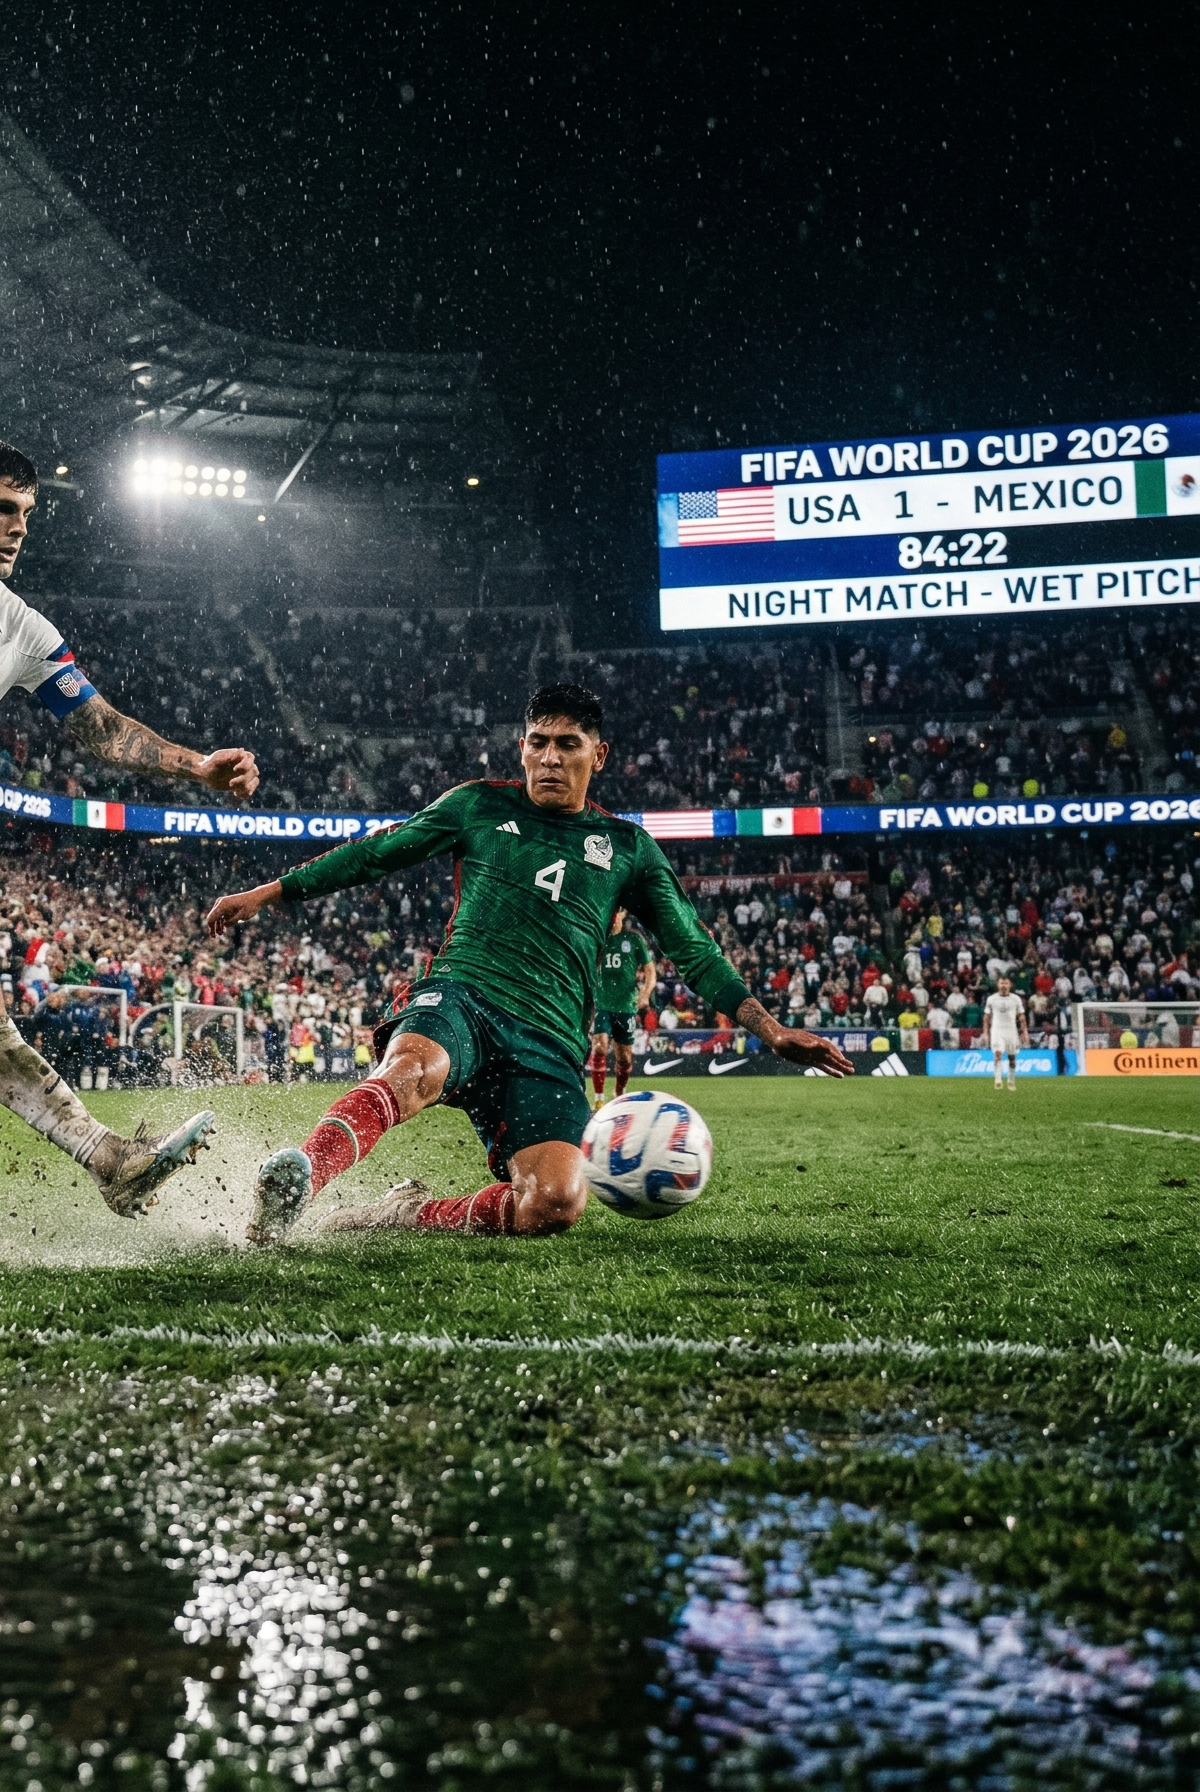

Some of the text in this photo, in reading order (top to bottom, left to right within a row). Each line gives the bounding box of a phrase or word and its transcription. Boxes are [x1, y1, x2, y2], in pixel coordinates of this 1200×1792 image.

[741, 423, 1169, 483] FIFA WORLD CUP 2026
[788, 494, 861, 525] USA
[894, 491, 913, 519] 1
[974, 476, 1123, 513] MEXICO
[898, 531, 1008, 569] 84:22
[728, 588, 833, 619] NIGHT
[846, 581, 968, 613] MATCH
[1004, 573, 1083, 604] WET
[1097, 567, 1200, 599] PITCH
[164, 811, 214, 833] FIFA
[216, 814, 304, 837] WORLD
[308, 818, 361, 839] CUP
[879, 807, 943, 829] FIFA
[946, 804, 1056, 827] WORLD
[1061, 802, 1125, 823] CUP
[534, 859, 567, 902] 4
[605, 953, 621, 969] 16
[1113, 1052, 1199, 1074] Continen
